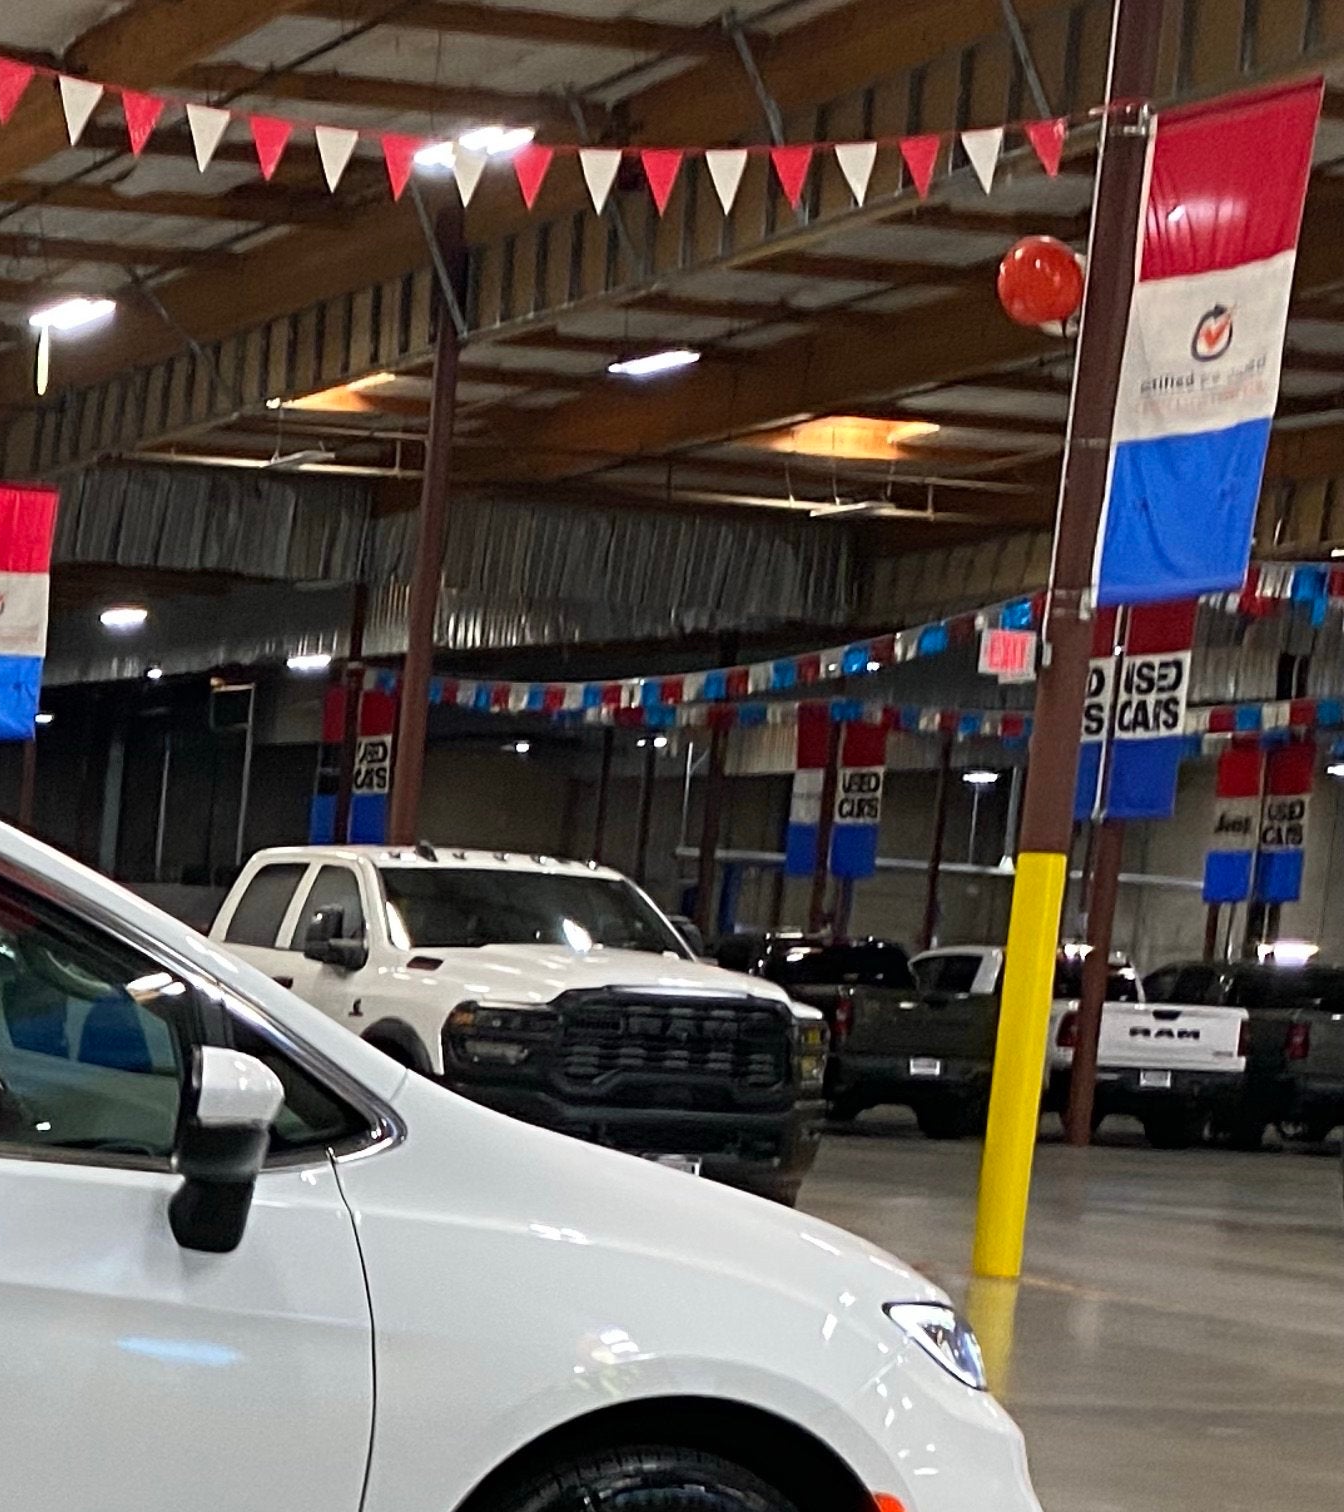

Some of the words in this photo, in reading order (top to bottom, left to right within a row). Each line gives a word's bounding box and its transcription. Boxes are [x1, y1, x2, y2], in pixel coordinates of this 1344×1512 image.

[988, 632, 1027, 670] EXIT
[1123, 659, 1183, 695] USED
[1128, 1026, 1201, 1041] RAM
